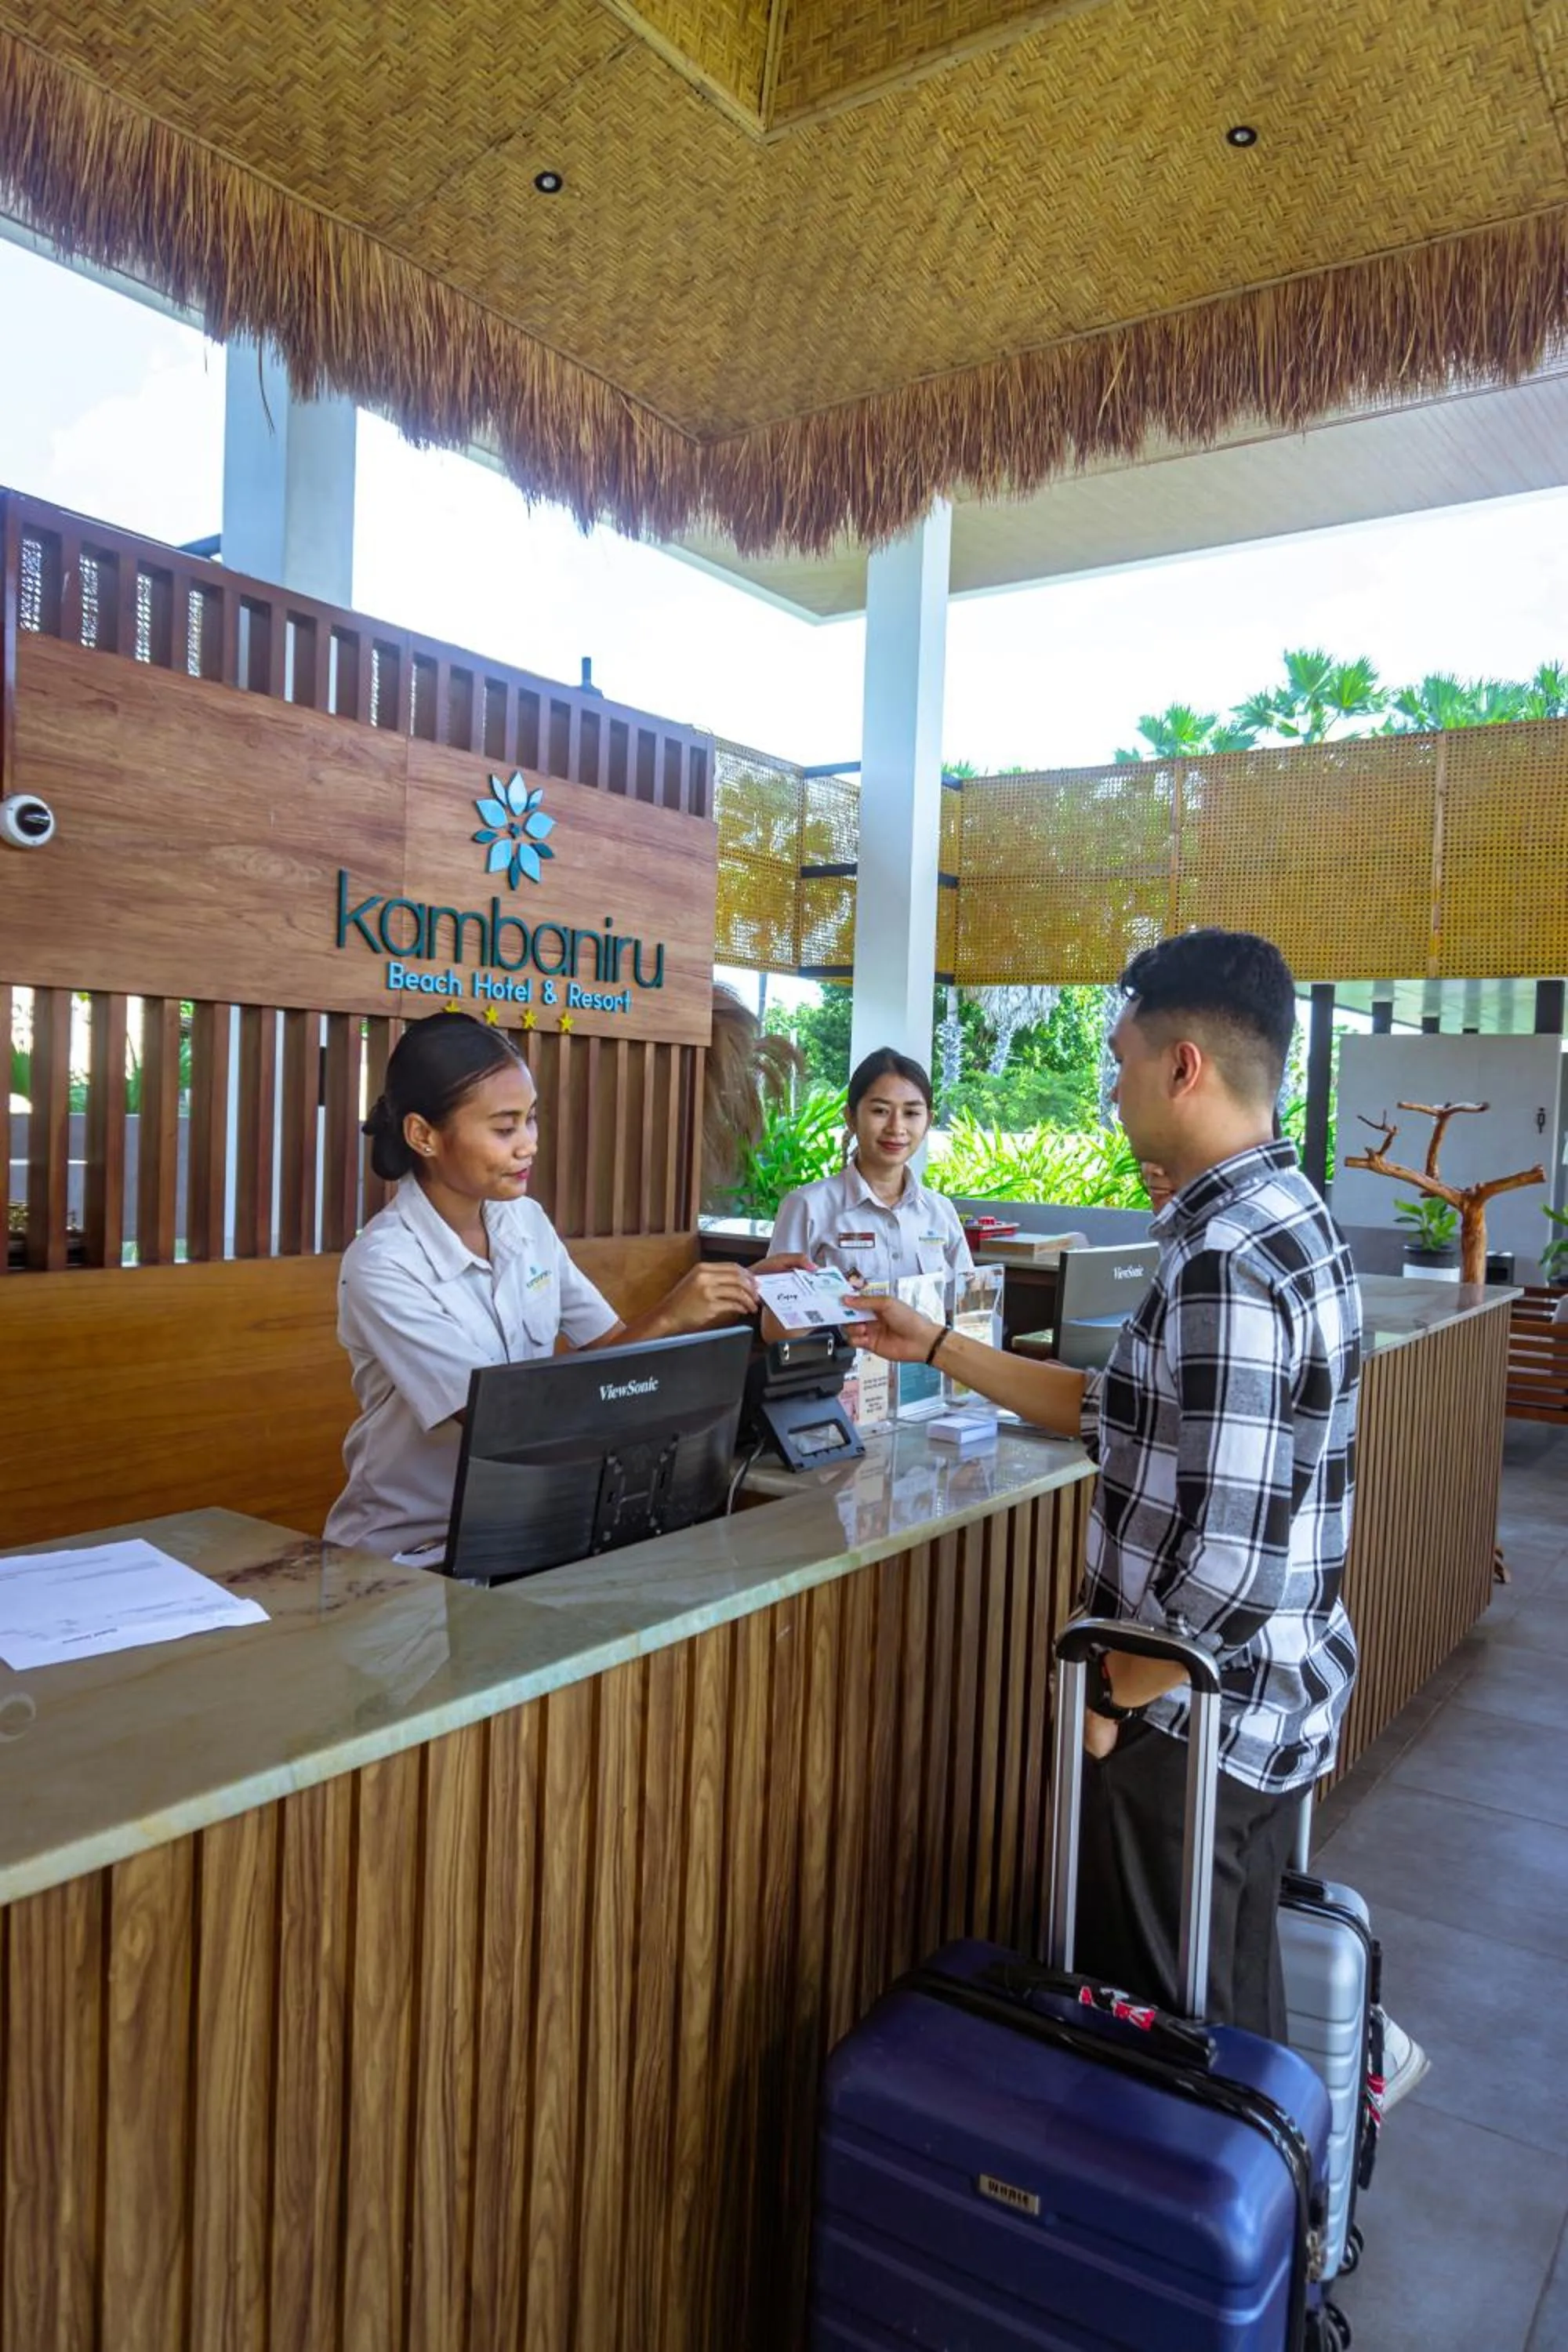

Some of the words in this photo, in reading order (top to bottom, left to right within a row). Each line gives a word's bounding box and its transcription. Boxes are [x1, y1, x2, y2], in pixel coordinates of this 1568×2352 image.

[336, 867, 666, 989] kambaniru
[387, 961, 463, 998] Beach
[472, 971, 534, 1004] Hotel
[543, 979, 559, 1006] &
[567, 982, 632, 1014] Resort
[599, 1375, 660, 1402] ViewSonic
